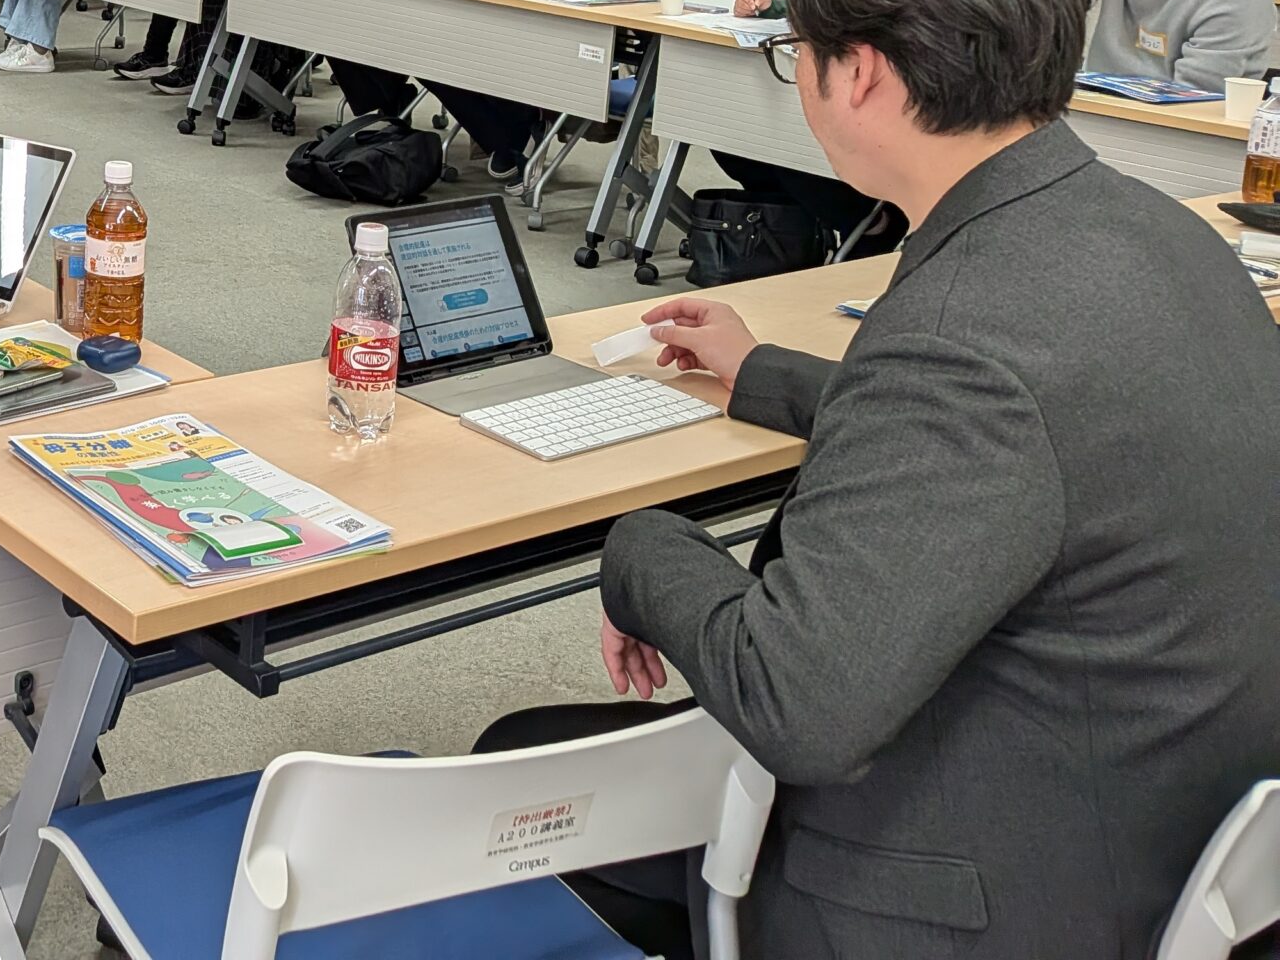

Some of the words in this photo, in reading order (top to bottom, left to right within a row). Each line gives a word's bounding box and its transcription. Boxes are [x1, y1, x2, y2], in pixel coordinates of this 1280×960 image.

[42, 438, 134, 455] 母子分離
[508, 856, 551, 873] Campus
